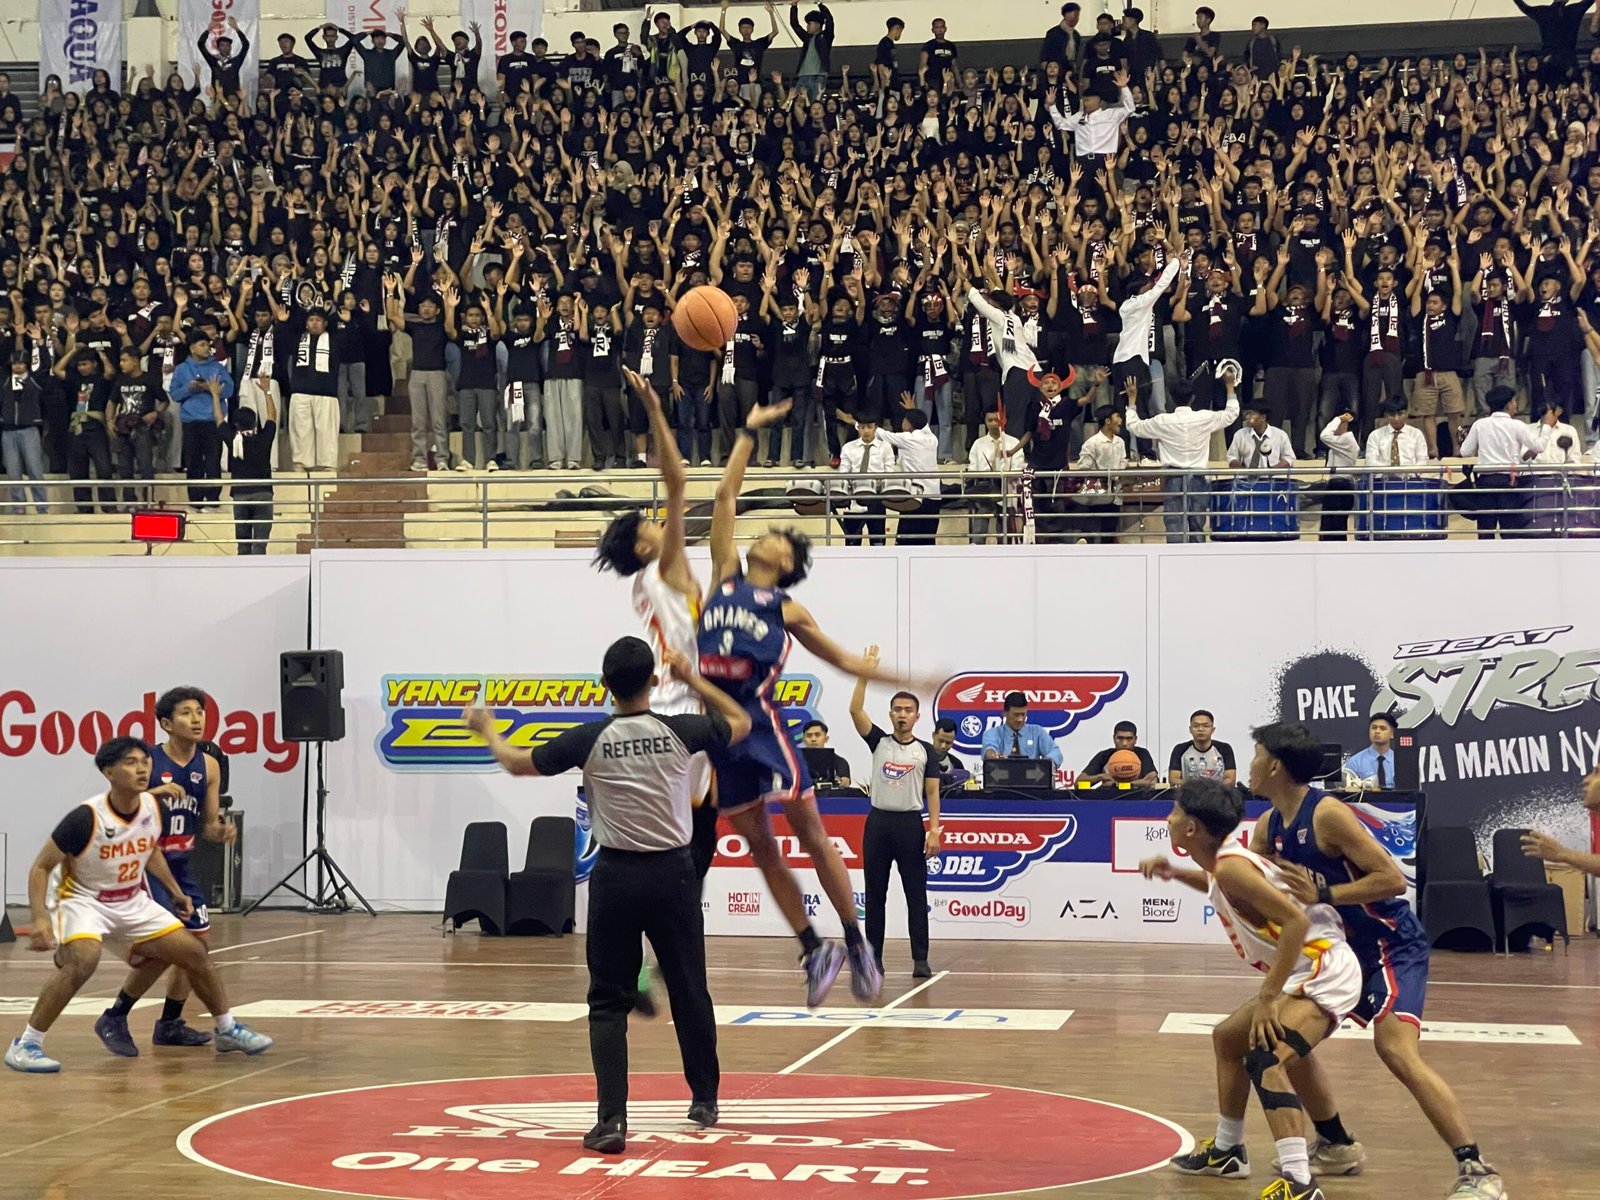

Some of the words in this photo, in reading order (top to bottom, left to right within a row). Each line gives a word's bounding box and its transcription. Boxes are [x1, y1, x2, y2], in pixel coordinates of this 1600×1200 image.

[64, 0, 98, 84] AQUA
[1006, 320, 1015, 337] 20
[1390, 317, 1399, 331] 20
[596, 336, 605, 353] 20
[1371, 332, 1380, 345] 19
[263, 346, 273, 358] 19
[298, 350, 308, 365] 20
[724, 350, 733, 365] 20
[514, 387, 523, 399] 19
[1026, 507, 1035, 520] 19
[387, 680, 481, 706] YANG
[485, 680, 608, 706] WORTH
[984, 690, 1081, 703] HNDA
[1297, 684, 1359, 721] PAKE
[1369, 649, 1600, 729] STRE
[0, 690, 156, 758] Good
[603, 736, 672, 759] REFEREE
[1455, 735, 1550, 780] MAKIN
[170, 814, 185, 835] 10
[944, 832, 1032, 845] HONDA
[118, 860, 140, 884] 22
[942, 855, 987, 876] DBL
[728, 892, 749, 903] HOT
[728, 904, 760, 913] CREAM
[948, 899, 991, 917] Good
[996, 901, 1026, 922] Day
[296, 1008, 511, 1016] CREAM
[331, 1151, 541, 1173] One
